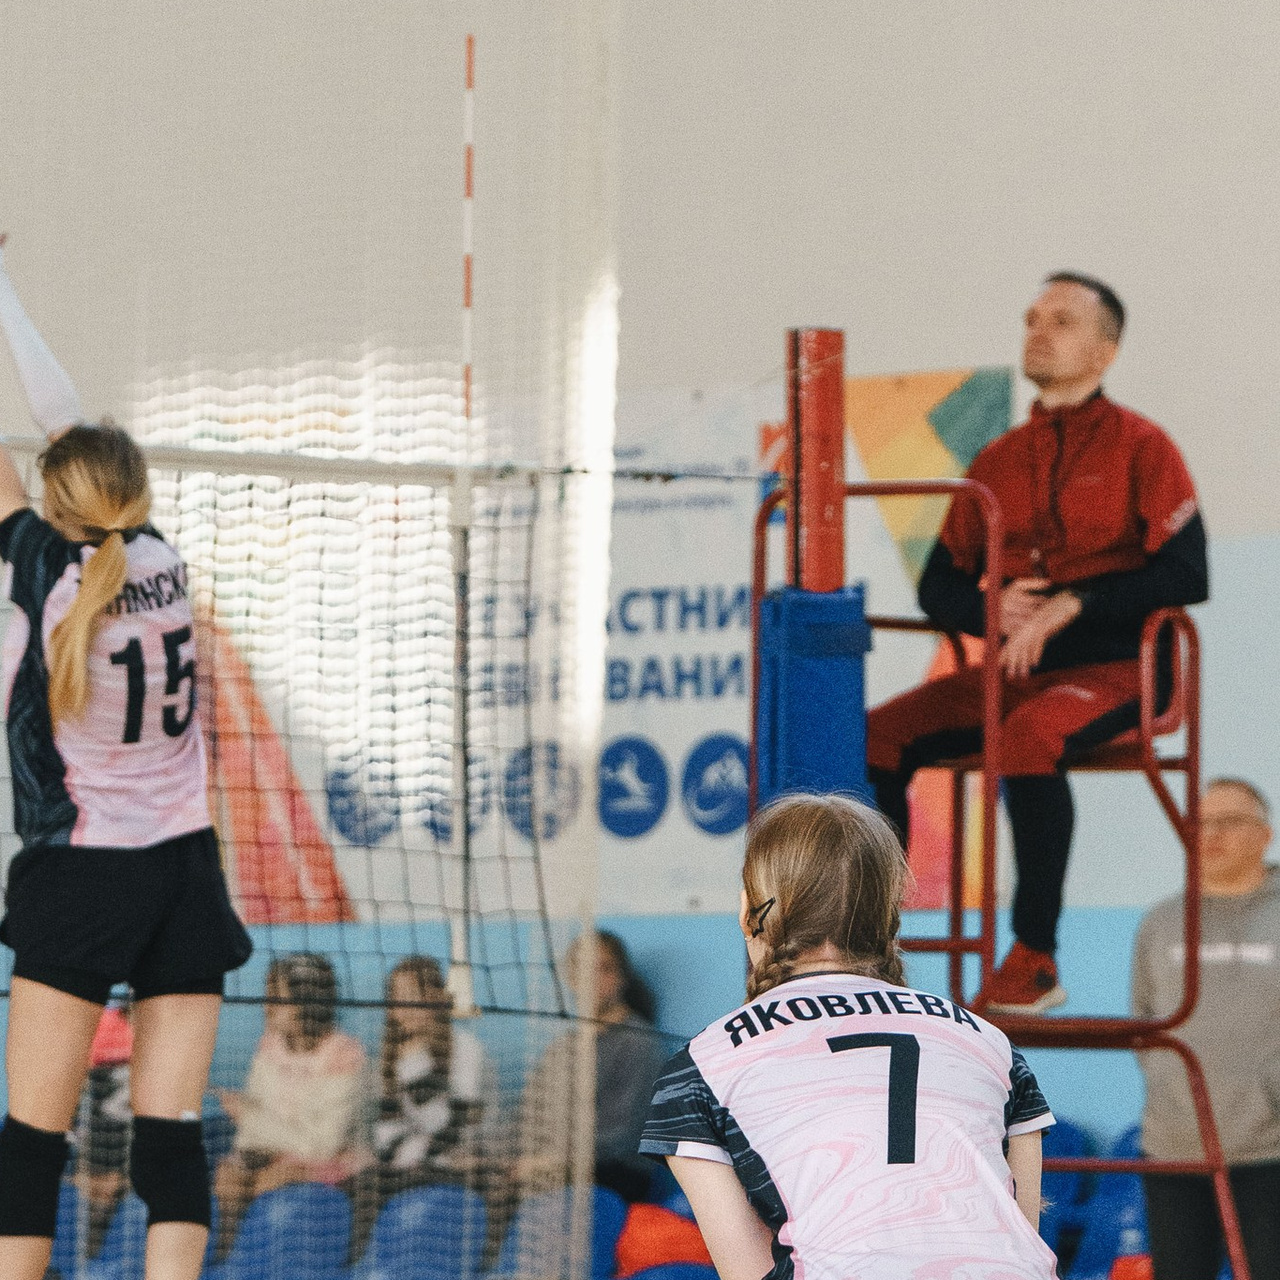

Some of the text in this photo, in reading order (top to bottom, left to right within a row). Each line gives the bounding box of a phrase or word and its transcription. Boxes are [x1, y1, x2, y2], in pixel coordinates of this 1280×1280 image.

[110, 626, 197, 743] 15
[723, 990, 982, 1048] ЯКОВЛЕВА
[826, 1032, 921, 1164] 7
